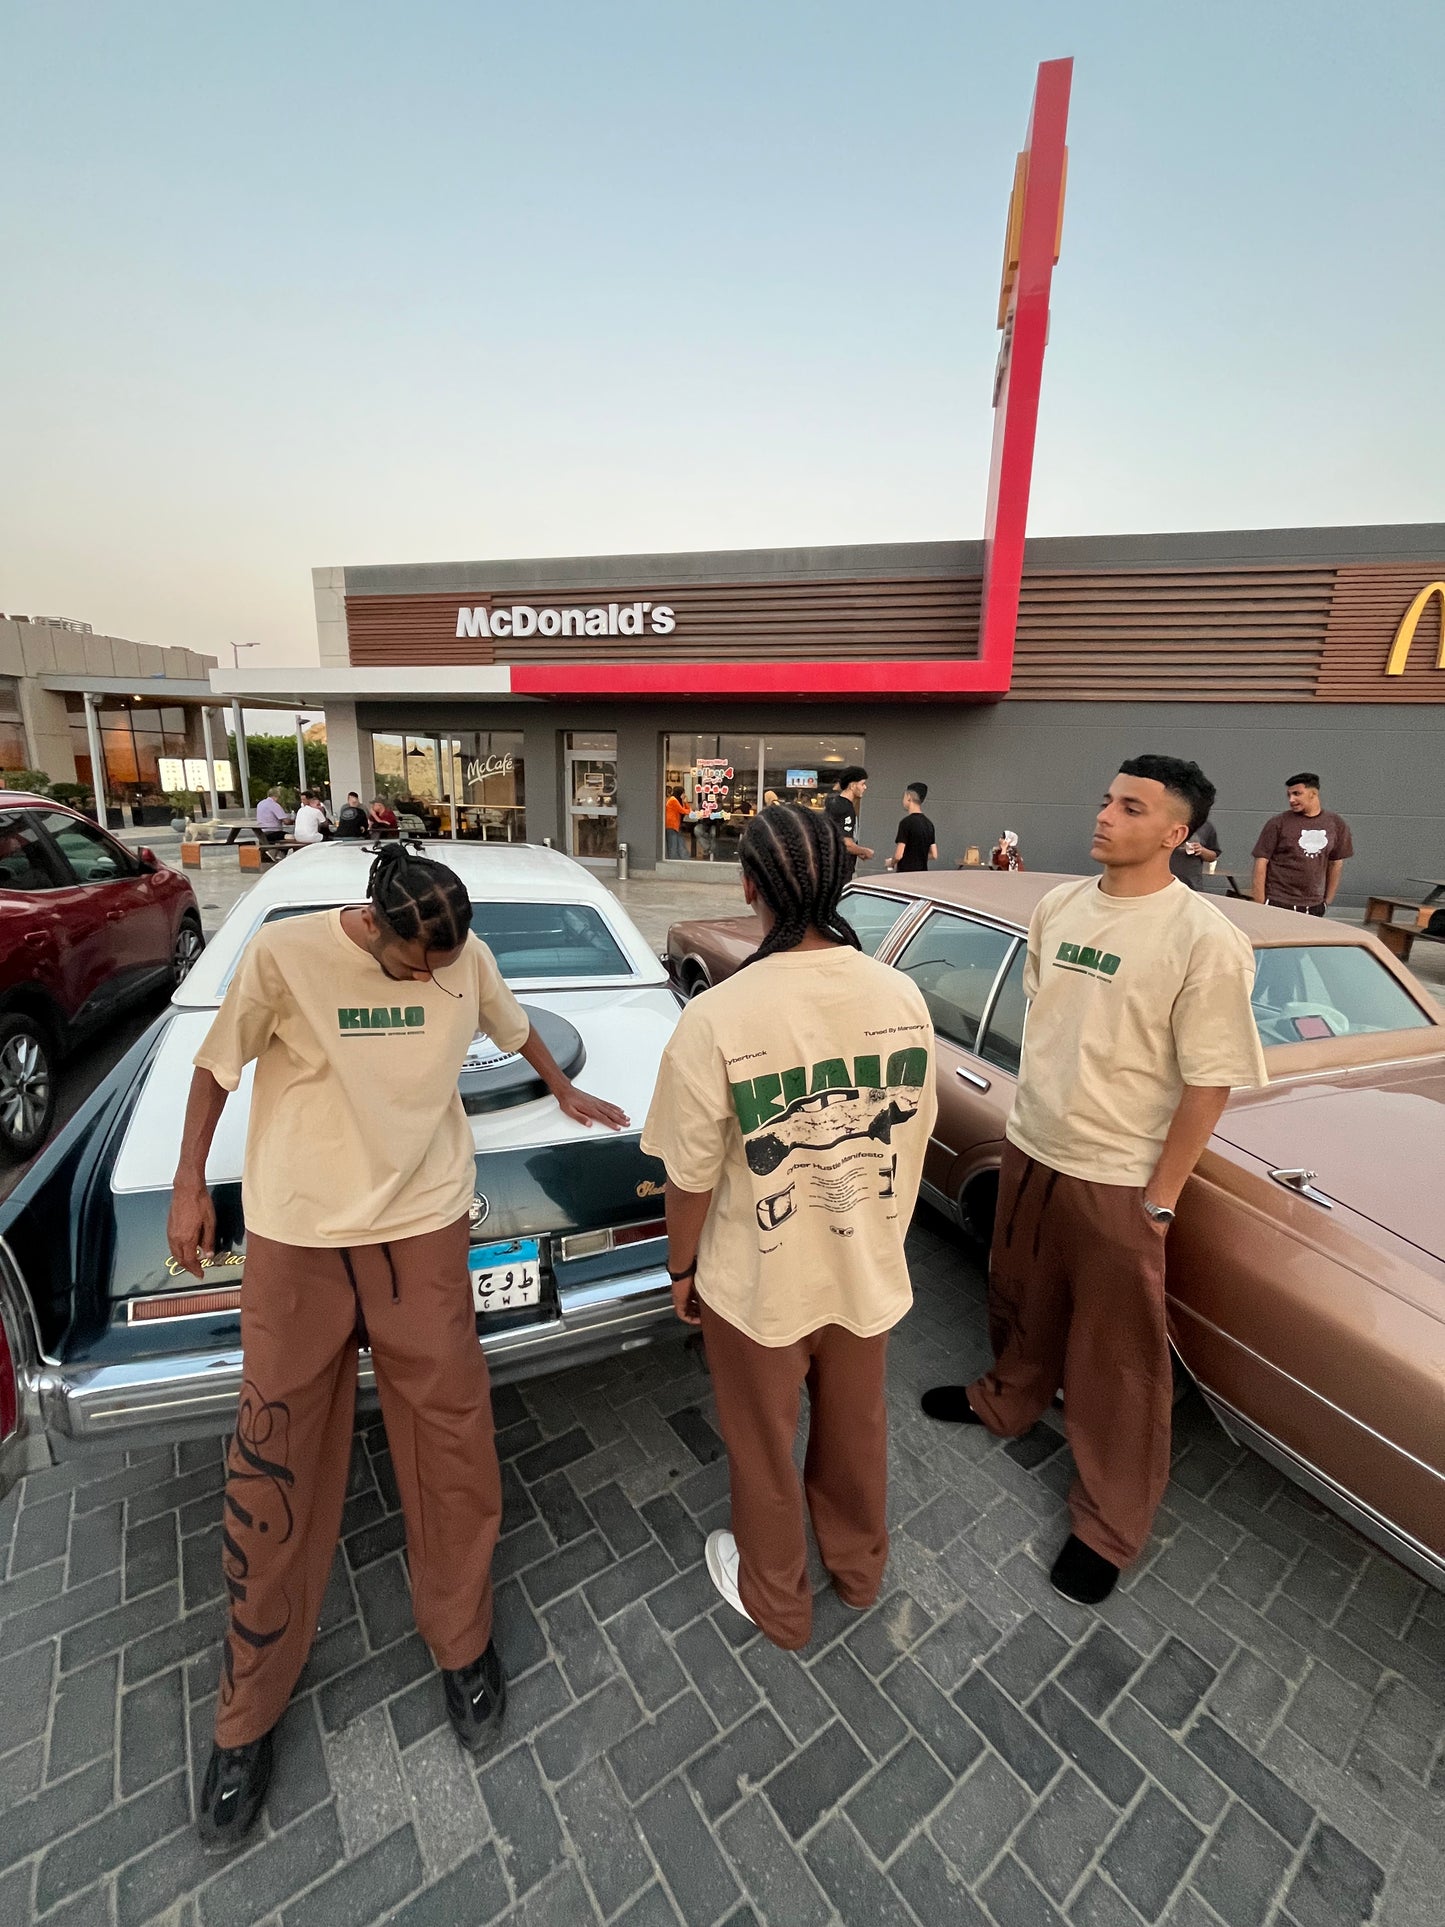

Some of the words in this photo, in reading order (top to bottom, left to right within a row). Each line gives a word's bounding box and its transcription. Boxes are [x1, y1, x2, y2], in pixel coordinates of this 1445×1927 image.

[456, 602, 676, 638] McDonald's
[467, 752, 513, 784] McCafé
[338, 1006, 425, 1029] KIALO
[863, 1028, 888, 1037] Tuned
[841, 1151, 884, 1164] Manifesto
